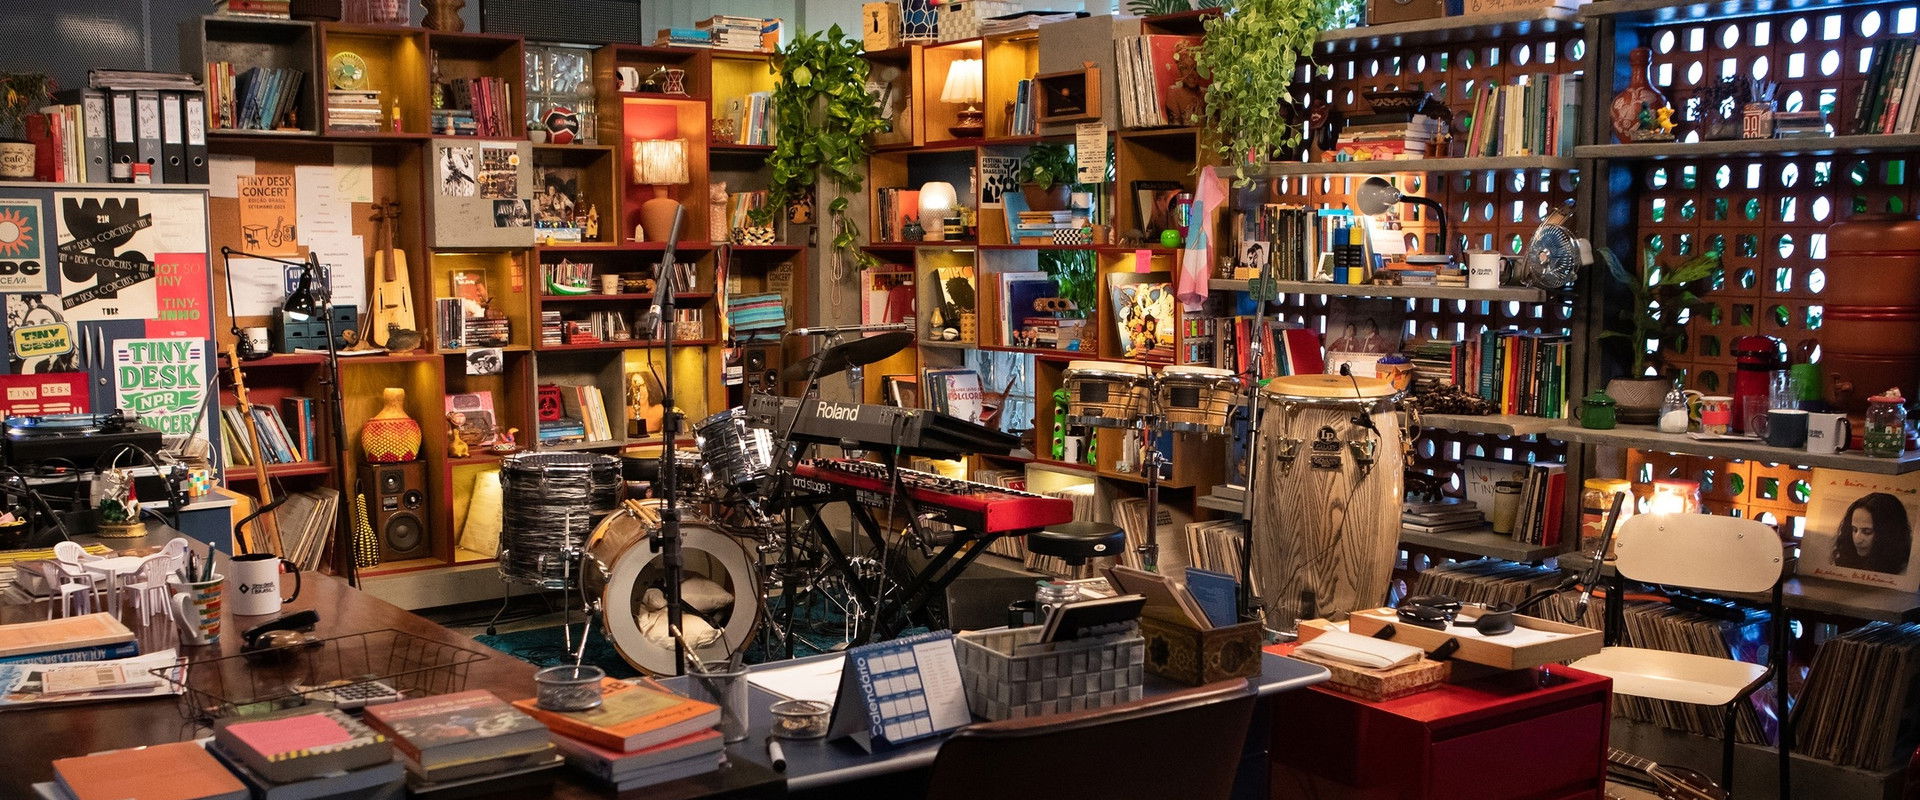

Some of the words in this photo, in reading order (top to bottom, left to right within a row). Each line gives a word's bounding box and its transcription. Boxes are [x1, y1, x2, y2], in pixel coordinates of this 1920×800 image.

[241, 176, 264, 186] TINY
[267, 176, 292, 186] DESK
[242, 187, 290, 197] CONCERT
[97, 224, 133, 242] CONCERTS
[95, 258, 132, 270] CONCERTS
[99, 276, 134, 295] CONCERTS
[22, 329, 60, 340] TINY
[20, 339, 66, 352] DESK
[127, 341, 193, 364] TINY
[119, 364, 201, 391] DESK
[9, 389, 35, 397] TINY
[43, 386, 70, 394] DESK
[140, 392, 176, 410] NPR
[816, 402, 861, 422] Roland
[806, 480, 826, 494] stage
[826, 482, 832, 494] 3
[57, 648, 106, 663] AQUARELA
[857, 656, 883, 737] Calendário
